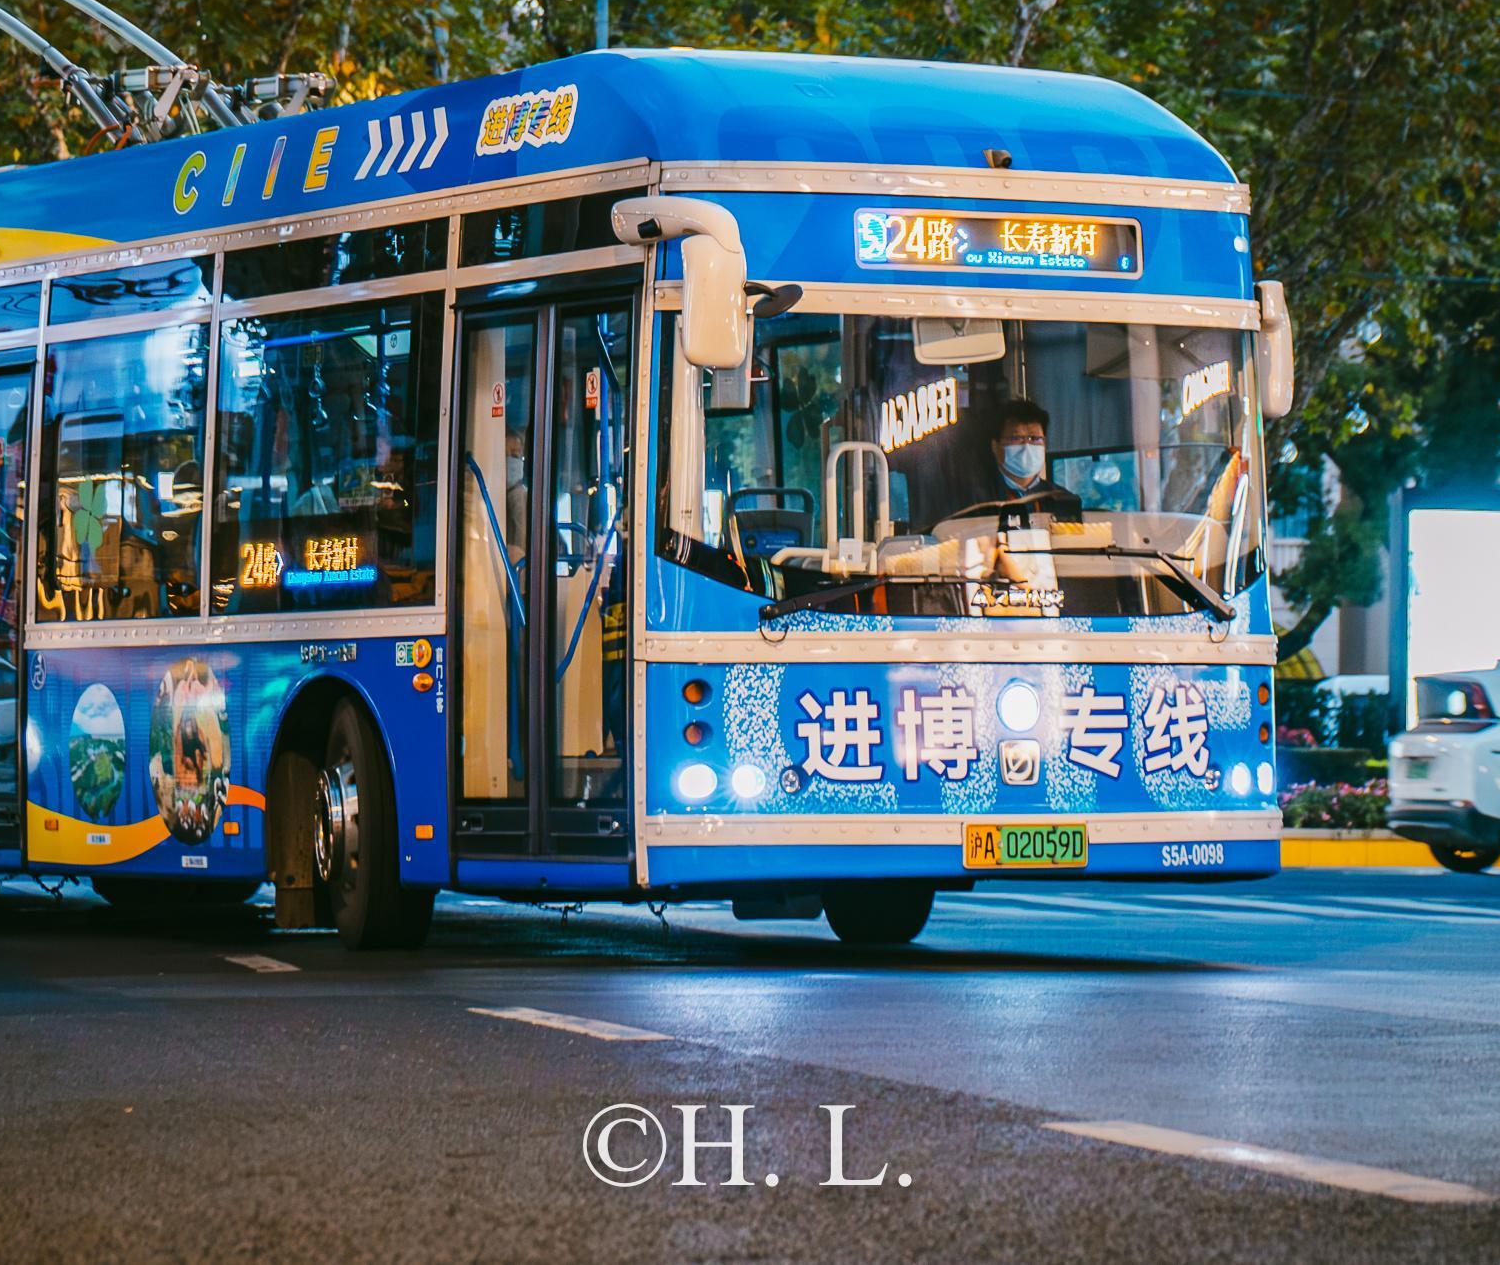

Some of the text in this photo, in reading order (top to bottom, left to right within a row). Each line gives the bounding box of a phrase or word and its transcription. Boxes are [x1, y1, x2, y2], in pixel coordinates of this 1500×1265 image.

[480, 91, 575, 150] 进博专线
[172, 125, 340, 216] CIIE
[999, 220, 1098, 257] 长寿新村
[798, 687, 1210, 781] 进博专线
[1161, 843, 1225, 867] S5A-0098
